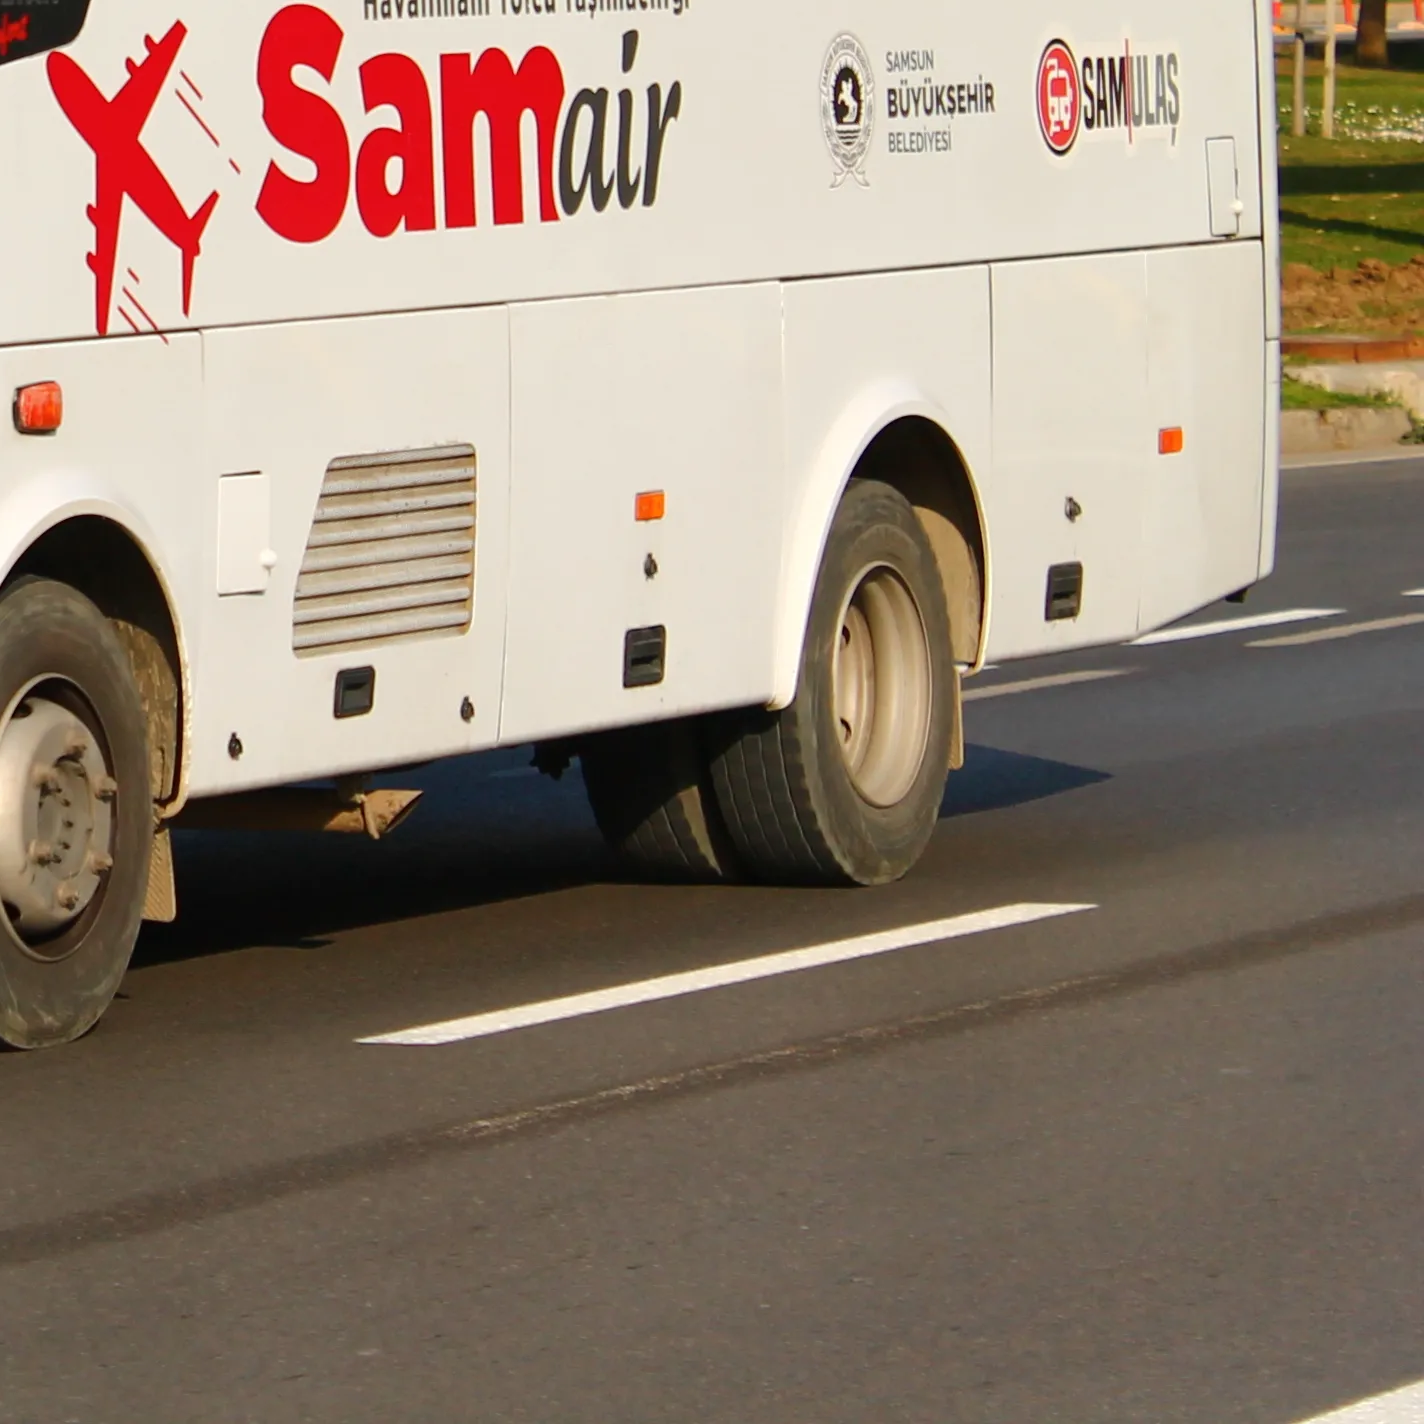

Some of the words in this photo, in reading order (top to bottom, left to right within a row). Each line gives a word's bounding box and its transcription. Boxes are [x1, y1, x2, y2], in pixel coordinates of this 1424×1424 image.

[886, 50, 934, 72] SAMSUN
[887, 74, 995, 119] BÜYÜKŞEHİR
[255, 3, 682, 243] Samair
[888, 124, 951, 153] BELEDİYESİ
